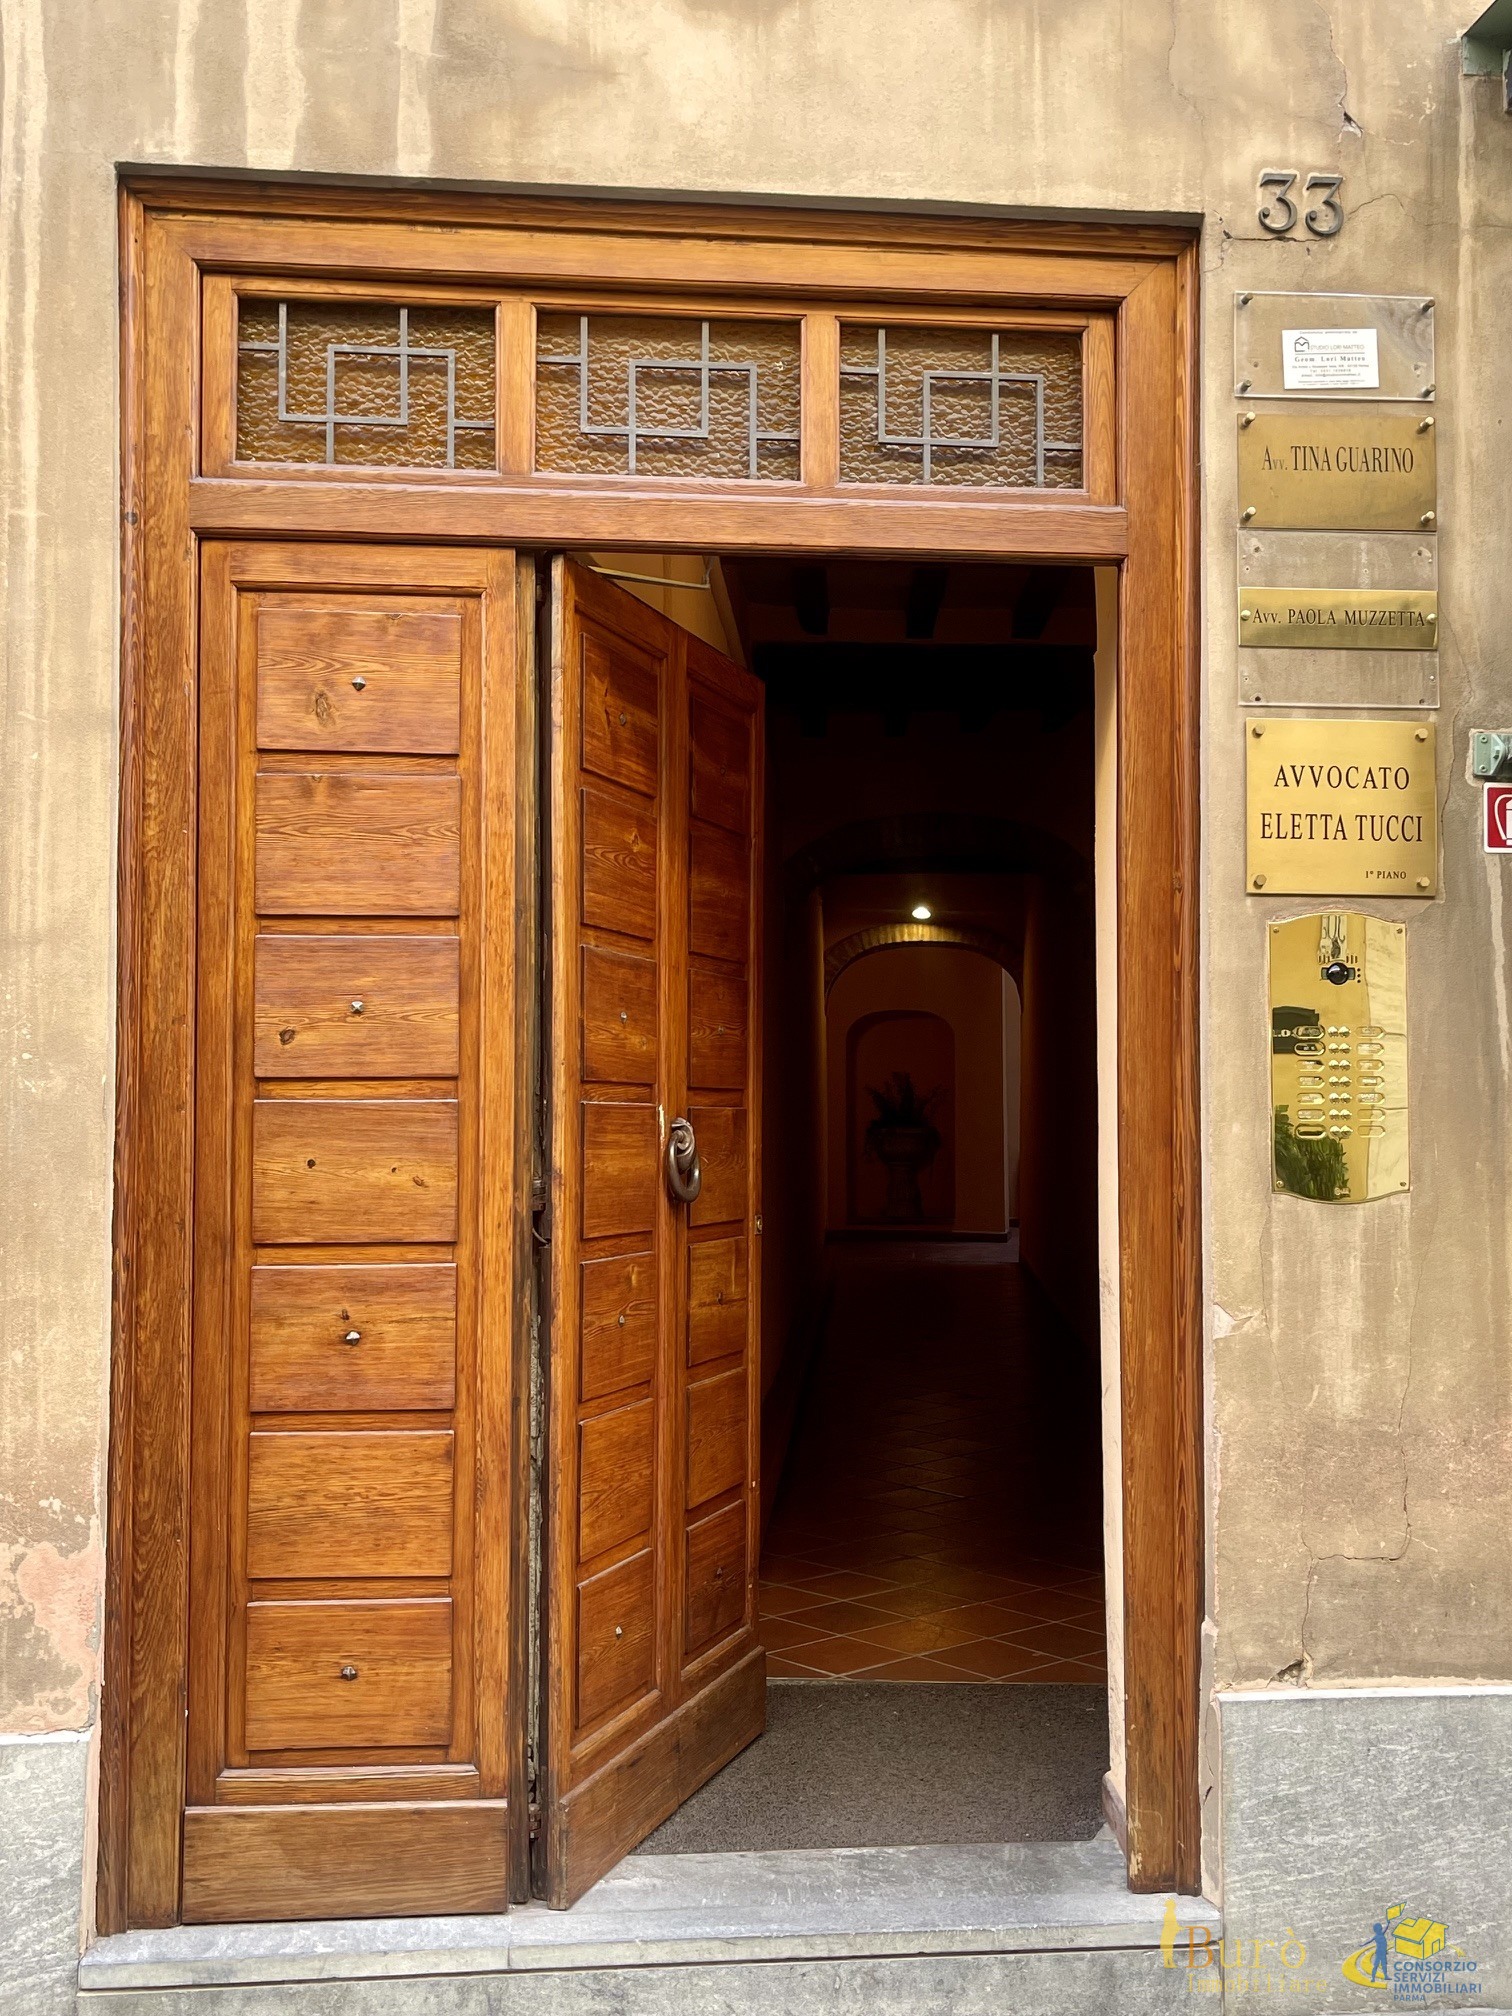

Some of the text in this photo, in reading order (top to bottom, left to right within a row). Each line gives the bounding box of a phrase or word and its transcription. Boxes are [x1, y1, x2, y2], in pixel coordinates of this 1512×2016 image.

[1258, 173, 1344, 236] 33
[1291, 445, 1331, 472] TINA
[1336, 447, 1414, 473] GUARINO
[1288, 609, 1337, 625] PAOLA
[1344, 610, 1425, 627] MUZZETTA
[1274, 765, 1410, 790] AVVOCATO
[1260, 813, 1423, 843] ELETTA TUCCI
[1377, 871, 1407, 880] PIANO
